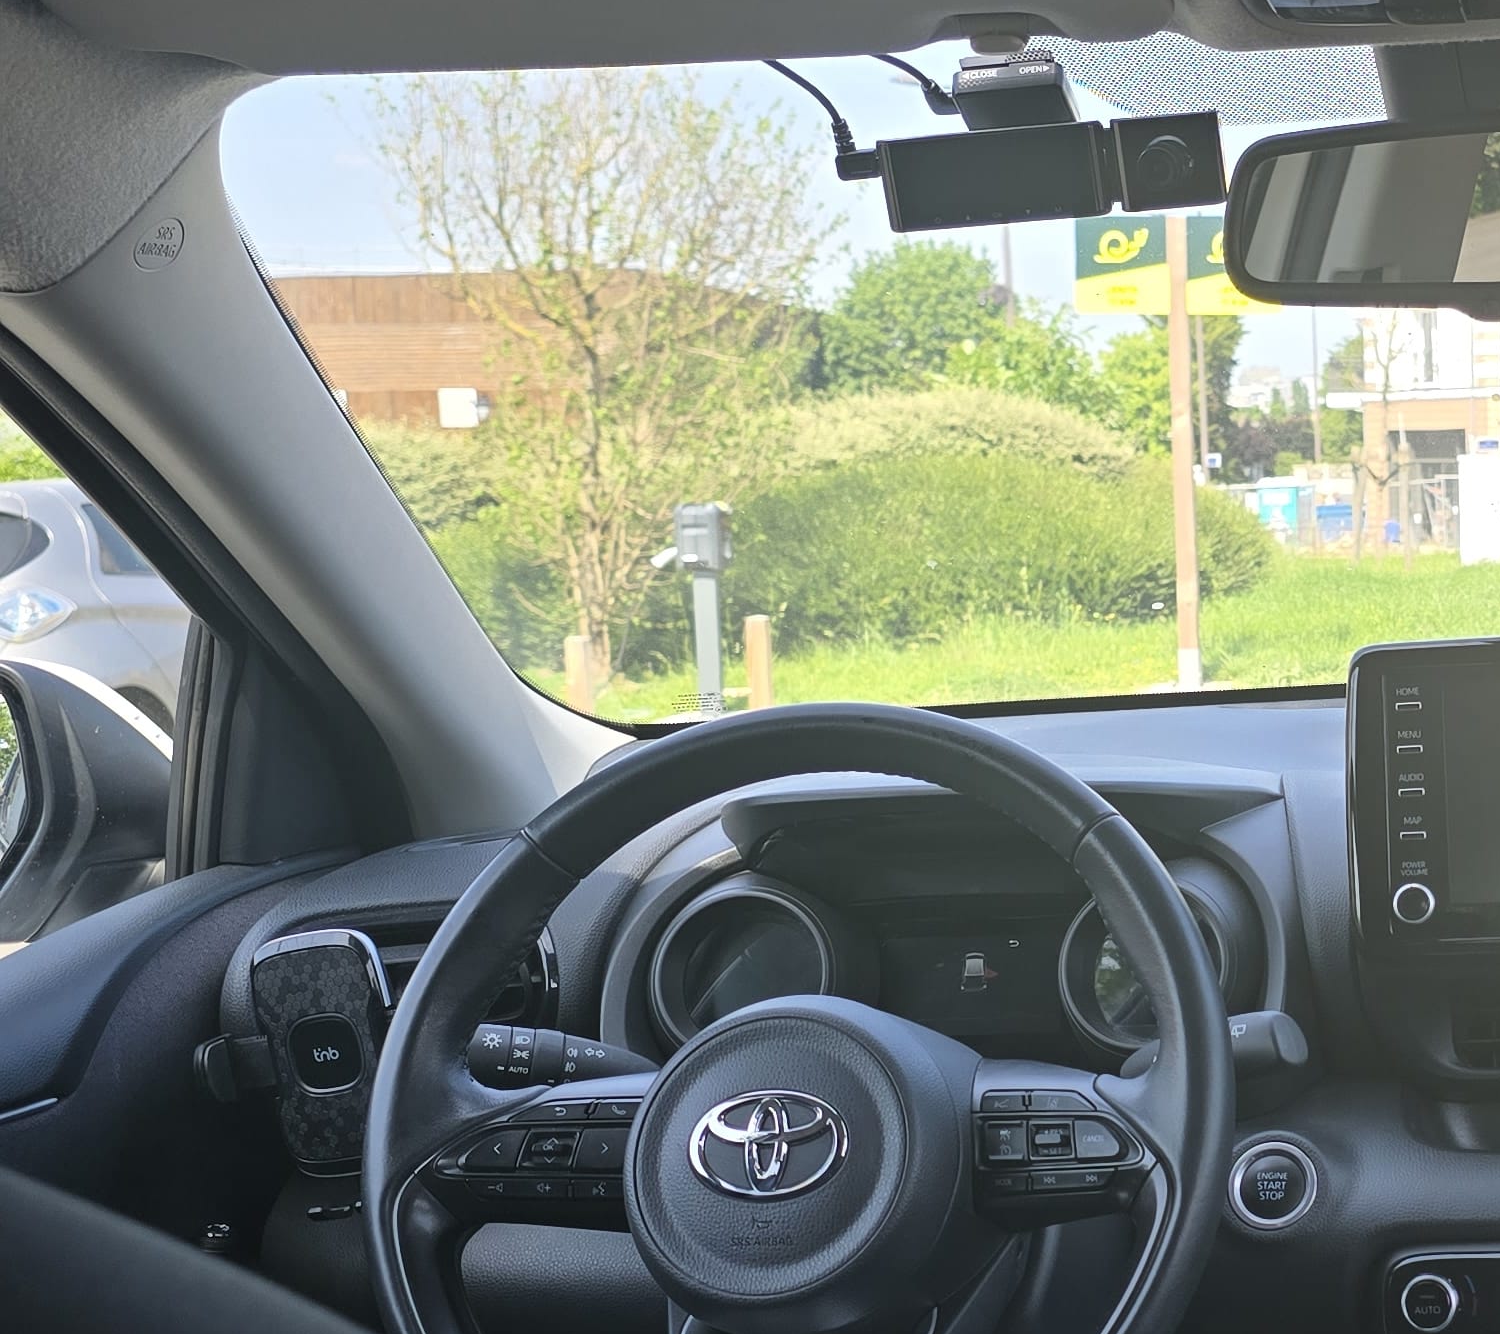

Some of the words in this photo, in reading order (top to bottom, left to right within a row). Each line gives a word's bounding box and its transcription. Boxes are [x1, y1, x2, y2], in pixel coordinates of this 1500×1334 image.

[970, 69, 998, 79] CLOSE
[1019, 65, 1043, 75] OPEN
[137, 242, 177, 258] AIRBAG
[1395, 687, 1420, 696] HOME
[1397, 730, 1422, 739] MENU
[1399, 772, 1425, 782] AUDIO
[1403, 816, 1423, 825] MAP
[1402, 861, 1426, 869] POWER
[1400, 868, 1429, 877] VOLUME
[313, 1046, 340, 1063] tnb
[508, 1066, 530, 1075] AUTO
[1256, 1171, 1289, 1180] ENGINE
[1257, 1180, 1287, 1191] START
[1259, 1190, 1285, 1201] STOP
[1414, 1305, 1441, 1315] AUTO
